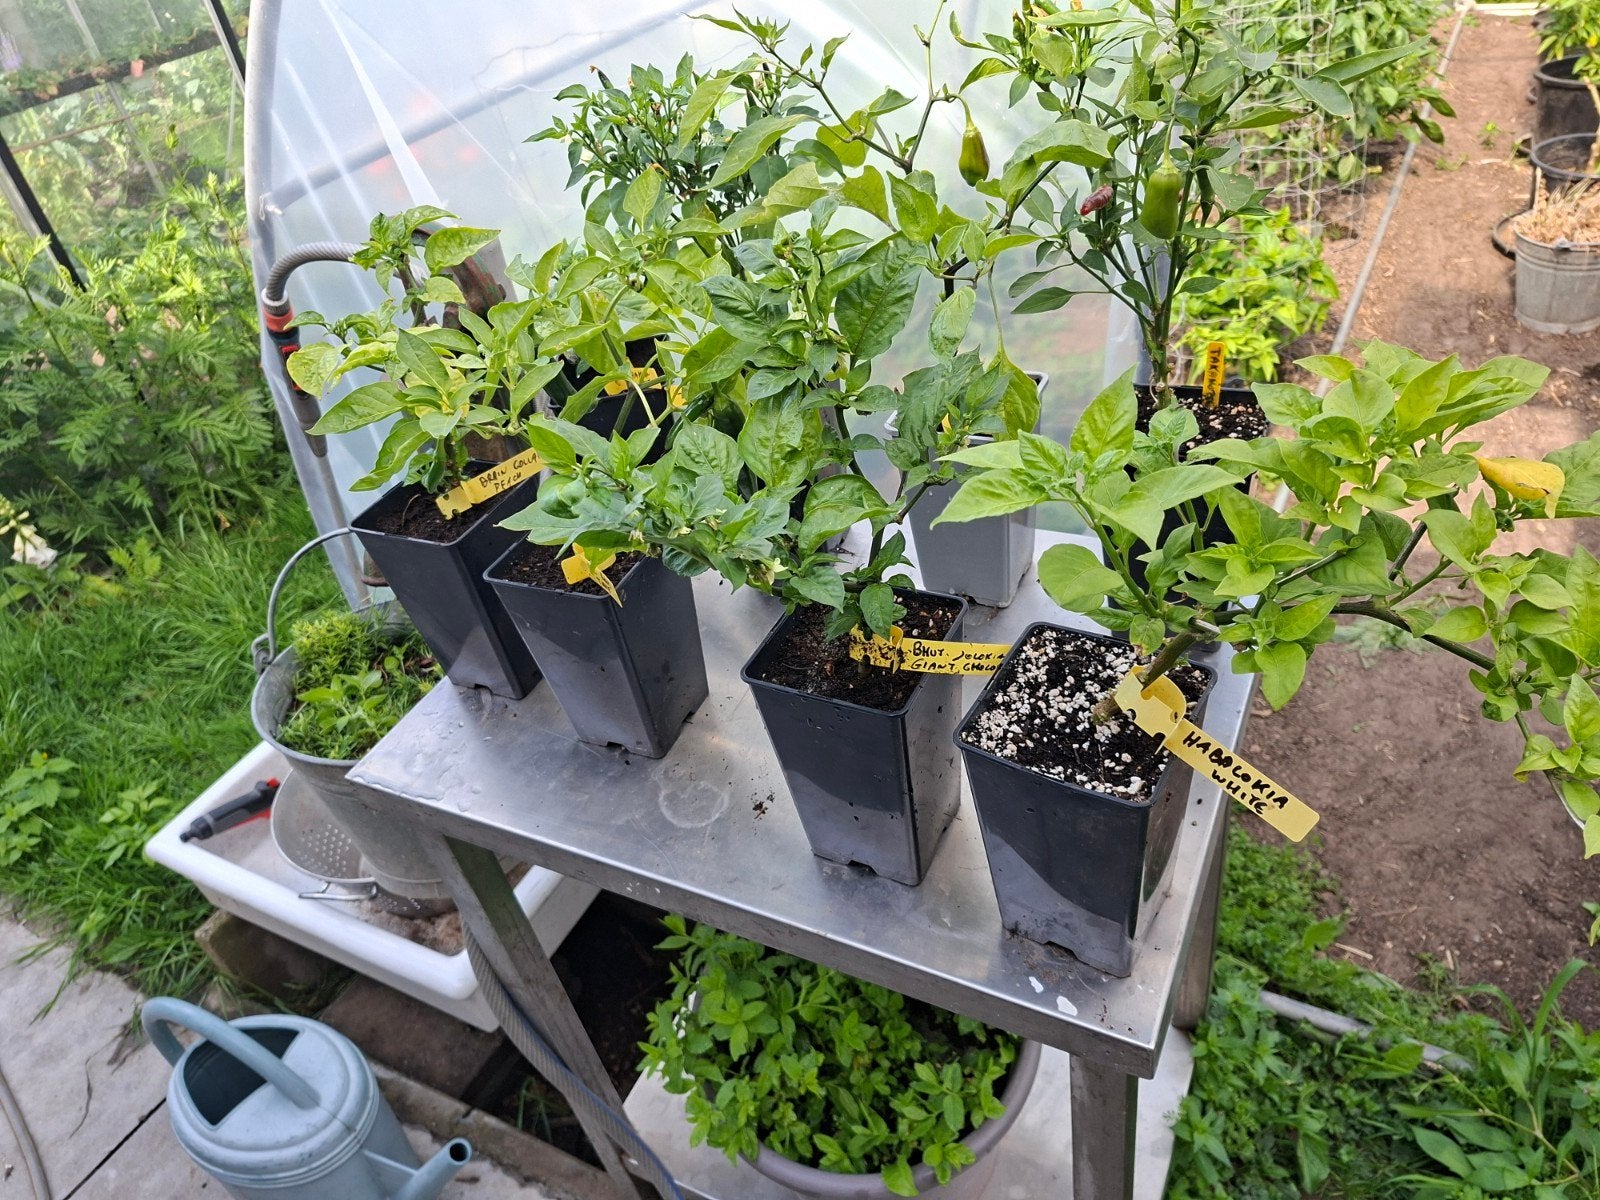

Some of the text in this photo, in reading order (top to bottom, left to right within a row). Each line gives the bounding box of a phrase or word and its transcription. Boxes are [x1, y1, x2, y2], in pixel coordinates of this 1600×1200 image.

[479, 453, 539, 488] BRAIN COLLA
[494, 472, 523, 492] PEACH
[910, 659, 955, 672] GIANT
[1211, 769, 1267, 815] WHITE
